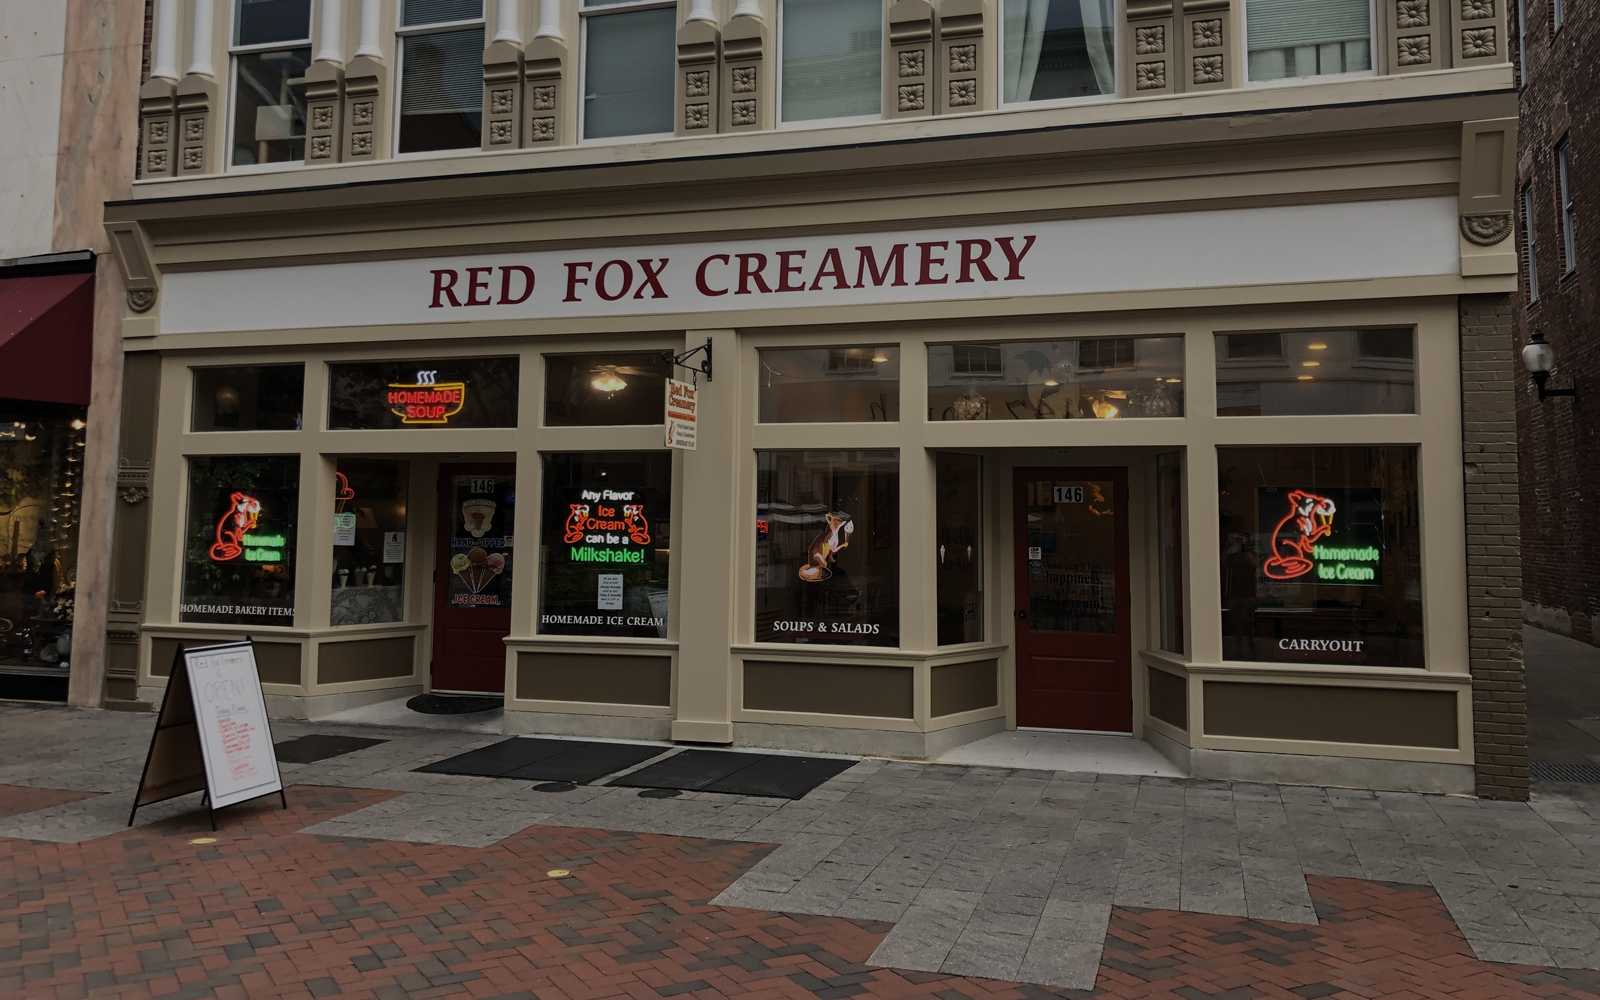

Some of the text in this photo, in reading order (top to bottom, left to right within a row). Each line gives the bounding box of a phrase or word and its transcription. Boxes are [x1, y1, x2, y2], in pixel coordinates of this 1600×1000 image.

[428, 235, 1037, 308] RED FOX CREAMERY
[387, 390, 460, 404] HOMEMADE
[670, 382, 695, 400] Red Fox
[406, 404, 445, 418] SOUP
[669, 394, 696, 414] Creamery
[473, 480, 493, 493] 146
[581, 489, 635, 503] Any Flavor
[1056, 487, 1082, 503] 146
[597, 504, 616, 517] Ice
[586, 517, 626, 531] Cream
[451, 536, 506, 548] HAND-DIPPED
[585, 532, 629, 545] can be a
[571, 546, 645, 564] Milkshake!
[1313, 545, 1380, 561] Homemade
[1045, 561, 1062, 570] You
[1064, 561, 1086, 571] can't
[1317, 562, 1375, 580] Ice Cream
[1045, 570, 1105, 588] happiness,
[453, 594, 499, 605] ICE CREAM
[180, 604, 234, 614] HOMEMADE
[235, 605, 268, 616] BAKERY
[541, 614, 664, 627] HOMEMADE ICE CREAM
[773, 620, 880, 634] SOUPS & SALADS
[1278, 638, 1364, 652] CARRYOUT
